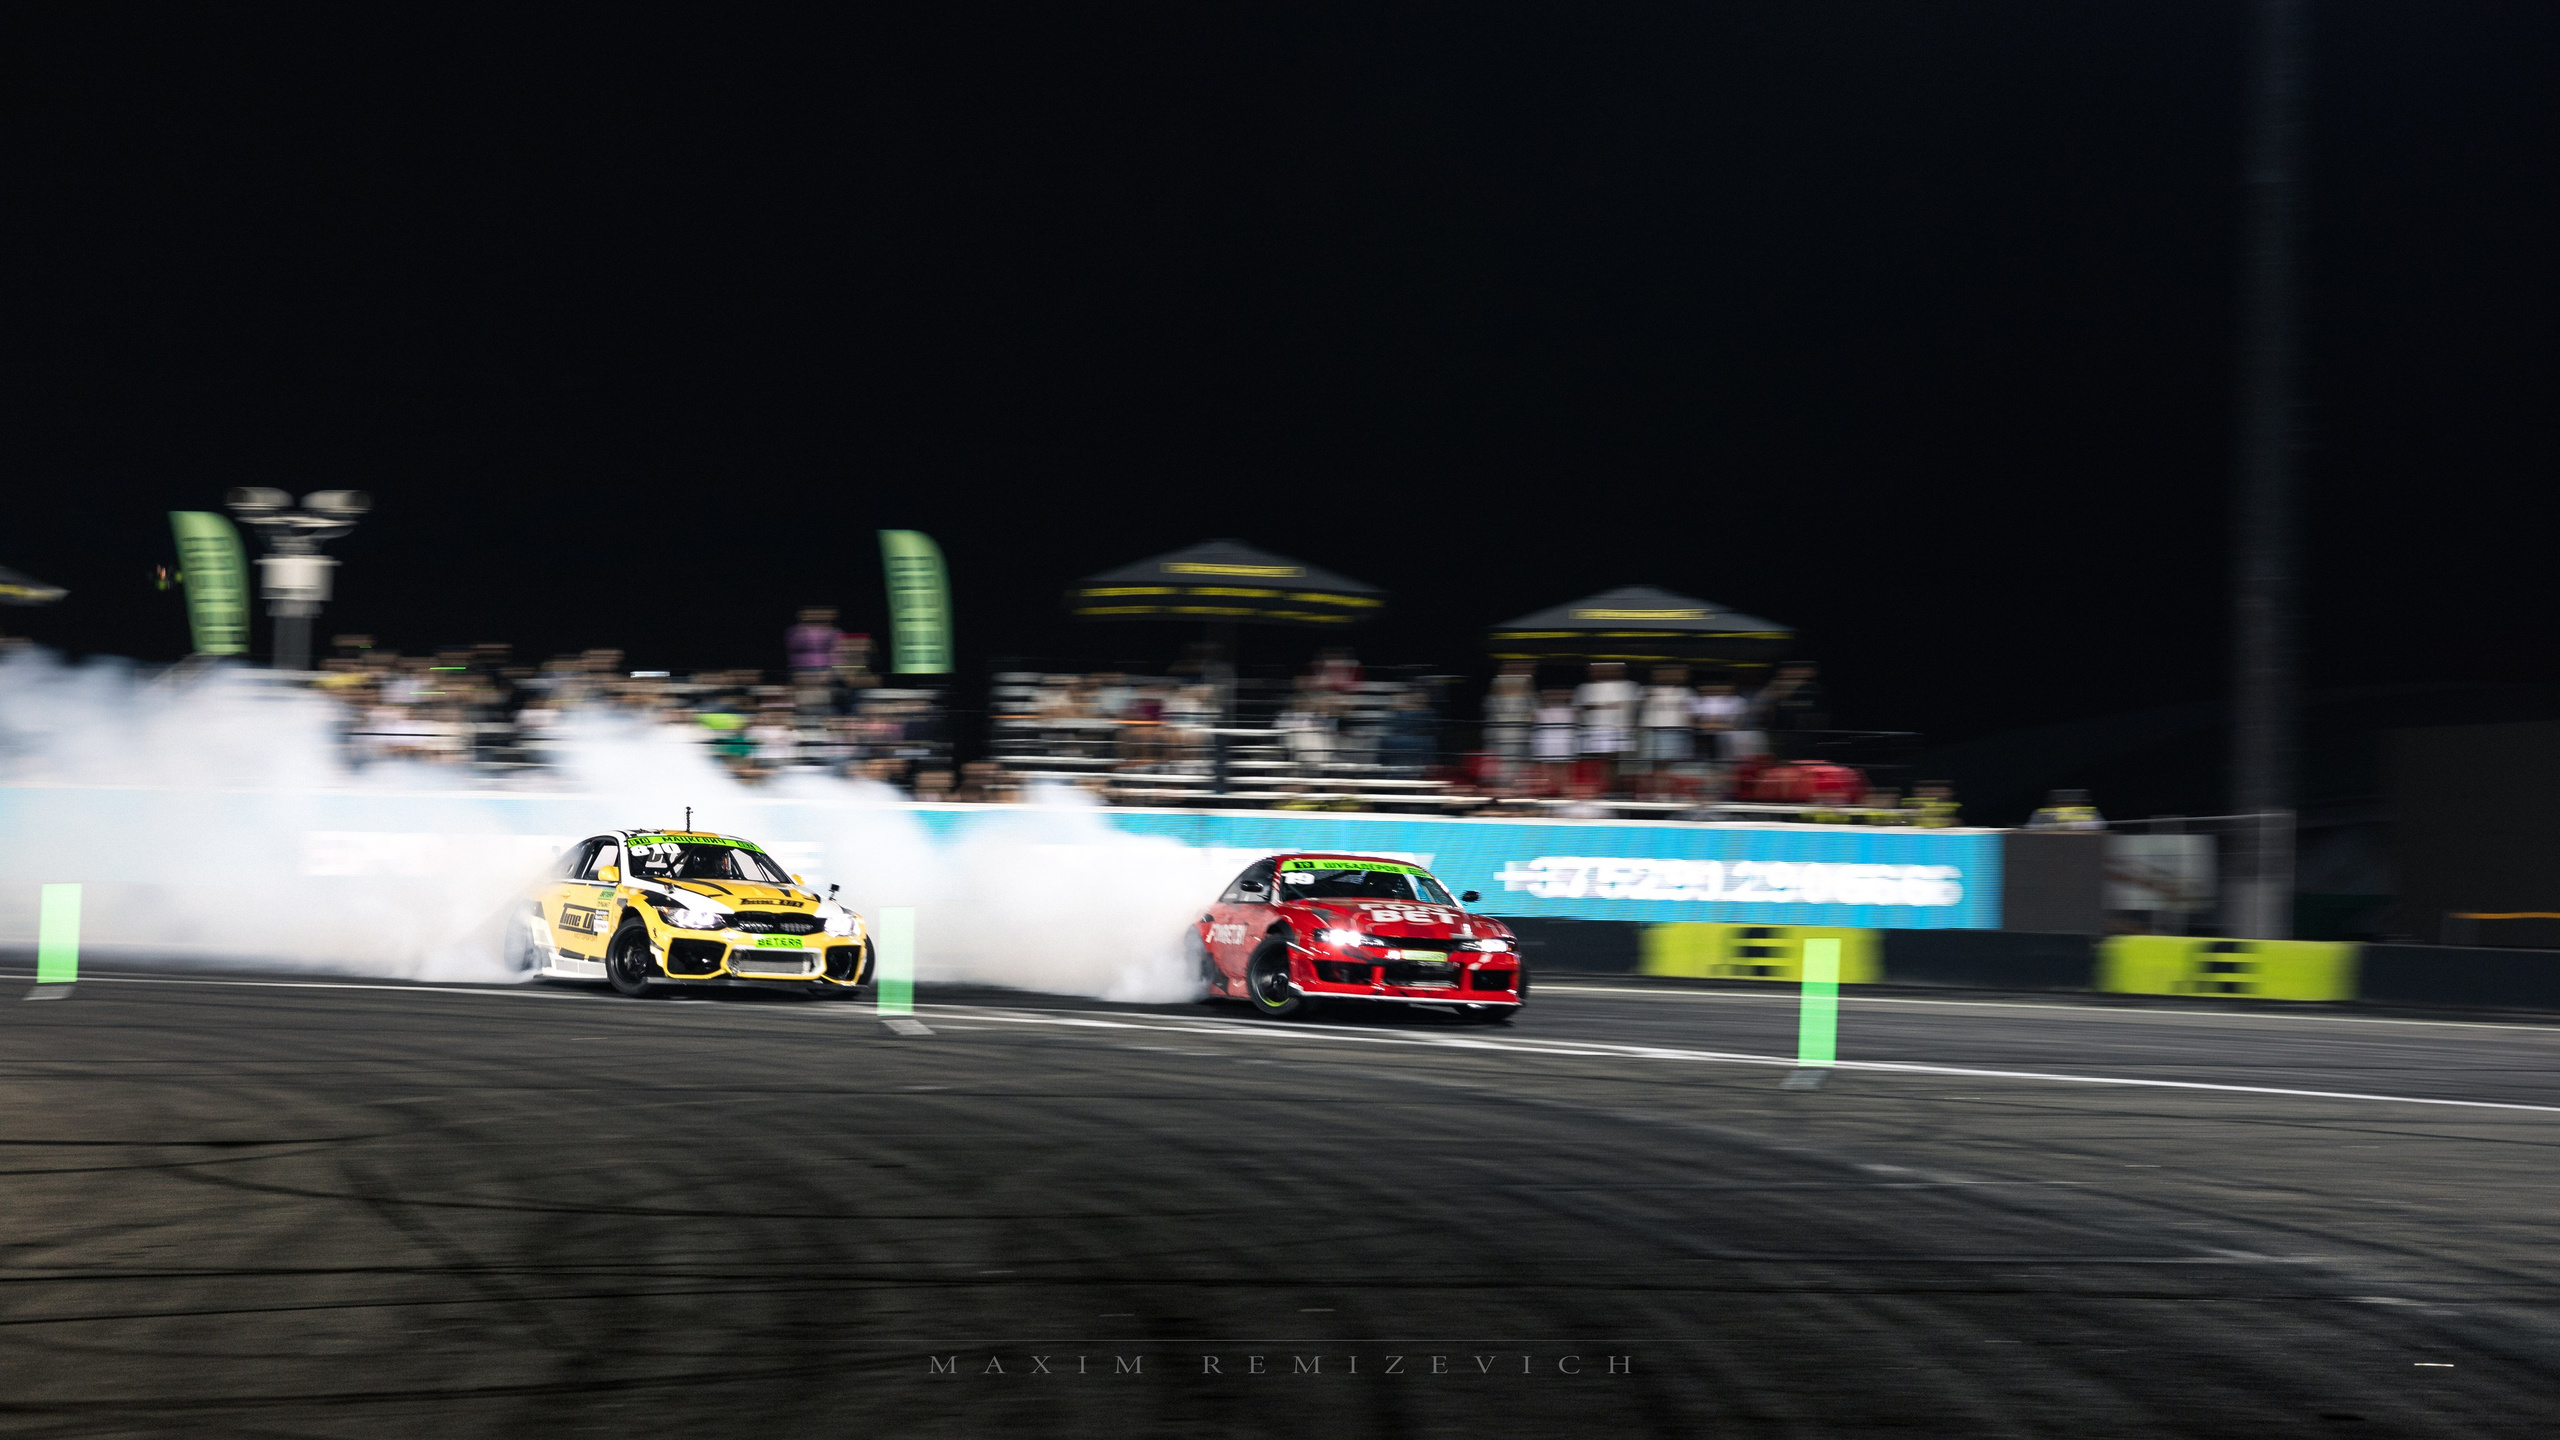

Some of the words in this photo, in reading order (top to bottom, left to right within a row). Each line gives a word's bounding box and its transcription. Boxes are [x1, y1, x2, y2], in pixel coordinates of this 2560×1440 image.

[661, 836, 727, 846] МАЦКЕВИЧ
[630, 843, 682, 857] 810
[1281, 872, 1315, 885] 19
[1371, 908, 1460, 924] BET
[757, 938, 802, 946] BETERA
